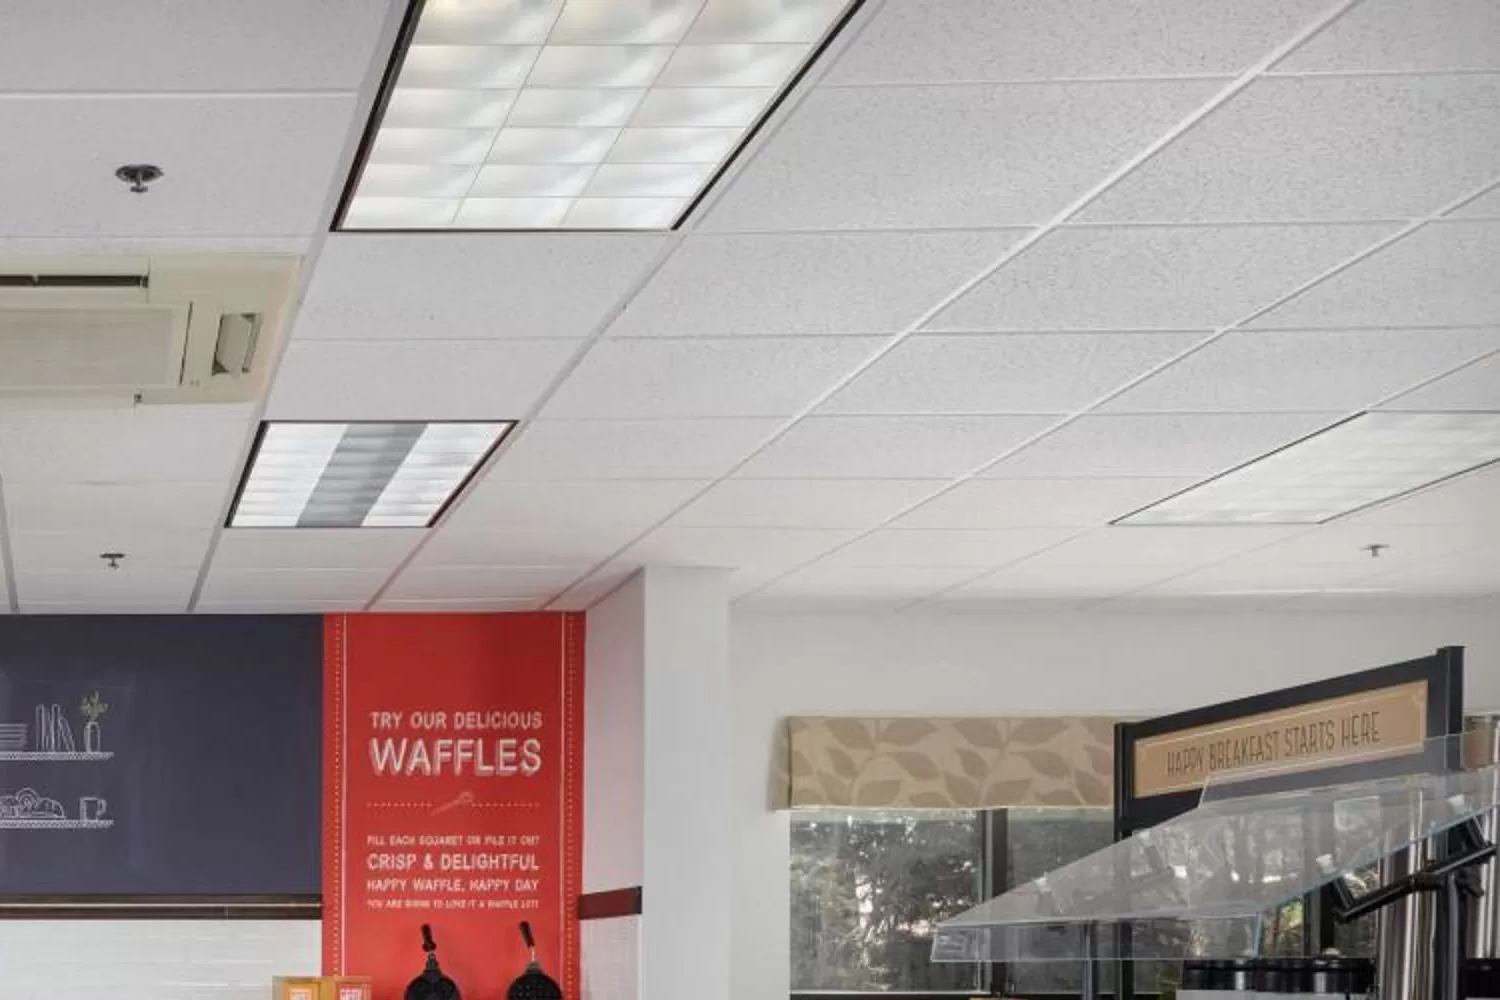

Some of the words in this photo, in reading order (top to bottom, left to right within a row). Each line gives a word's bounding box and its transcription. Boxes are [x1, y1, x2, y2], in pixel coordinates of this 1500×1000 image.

[370, 711, 402, 730] TRY
[410, 711, 447, 730] OUR
[453, 711, 543, 730] DELICIOUS
[1167, 746, 1204, 778] HAPPY
[1208, 730, 1281, 771] BREAKFAST
[1284, 719, 1335, 759] STARTS
[1340, 711, 1380, 746] HERE
[369, 737, 543, 777] WAFFLES
[366, 853, 417, 871] CRISP
[423, 853, 433, 871] &
[440, 853, 541, 871] DELIGHTFUL
[367, 879, 407, 893] HAPPY
[469, 879, 510, 893] HAPPY
[515, 879, 540, 892] DAY
